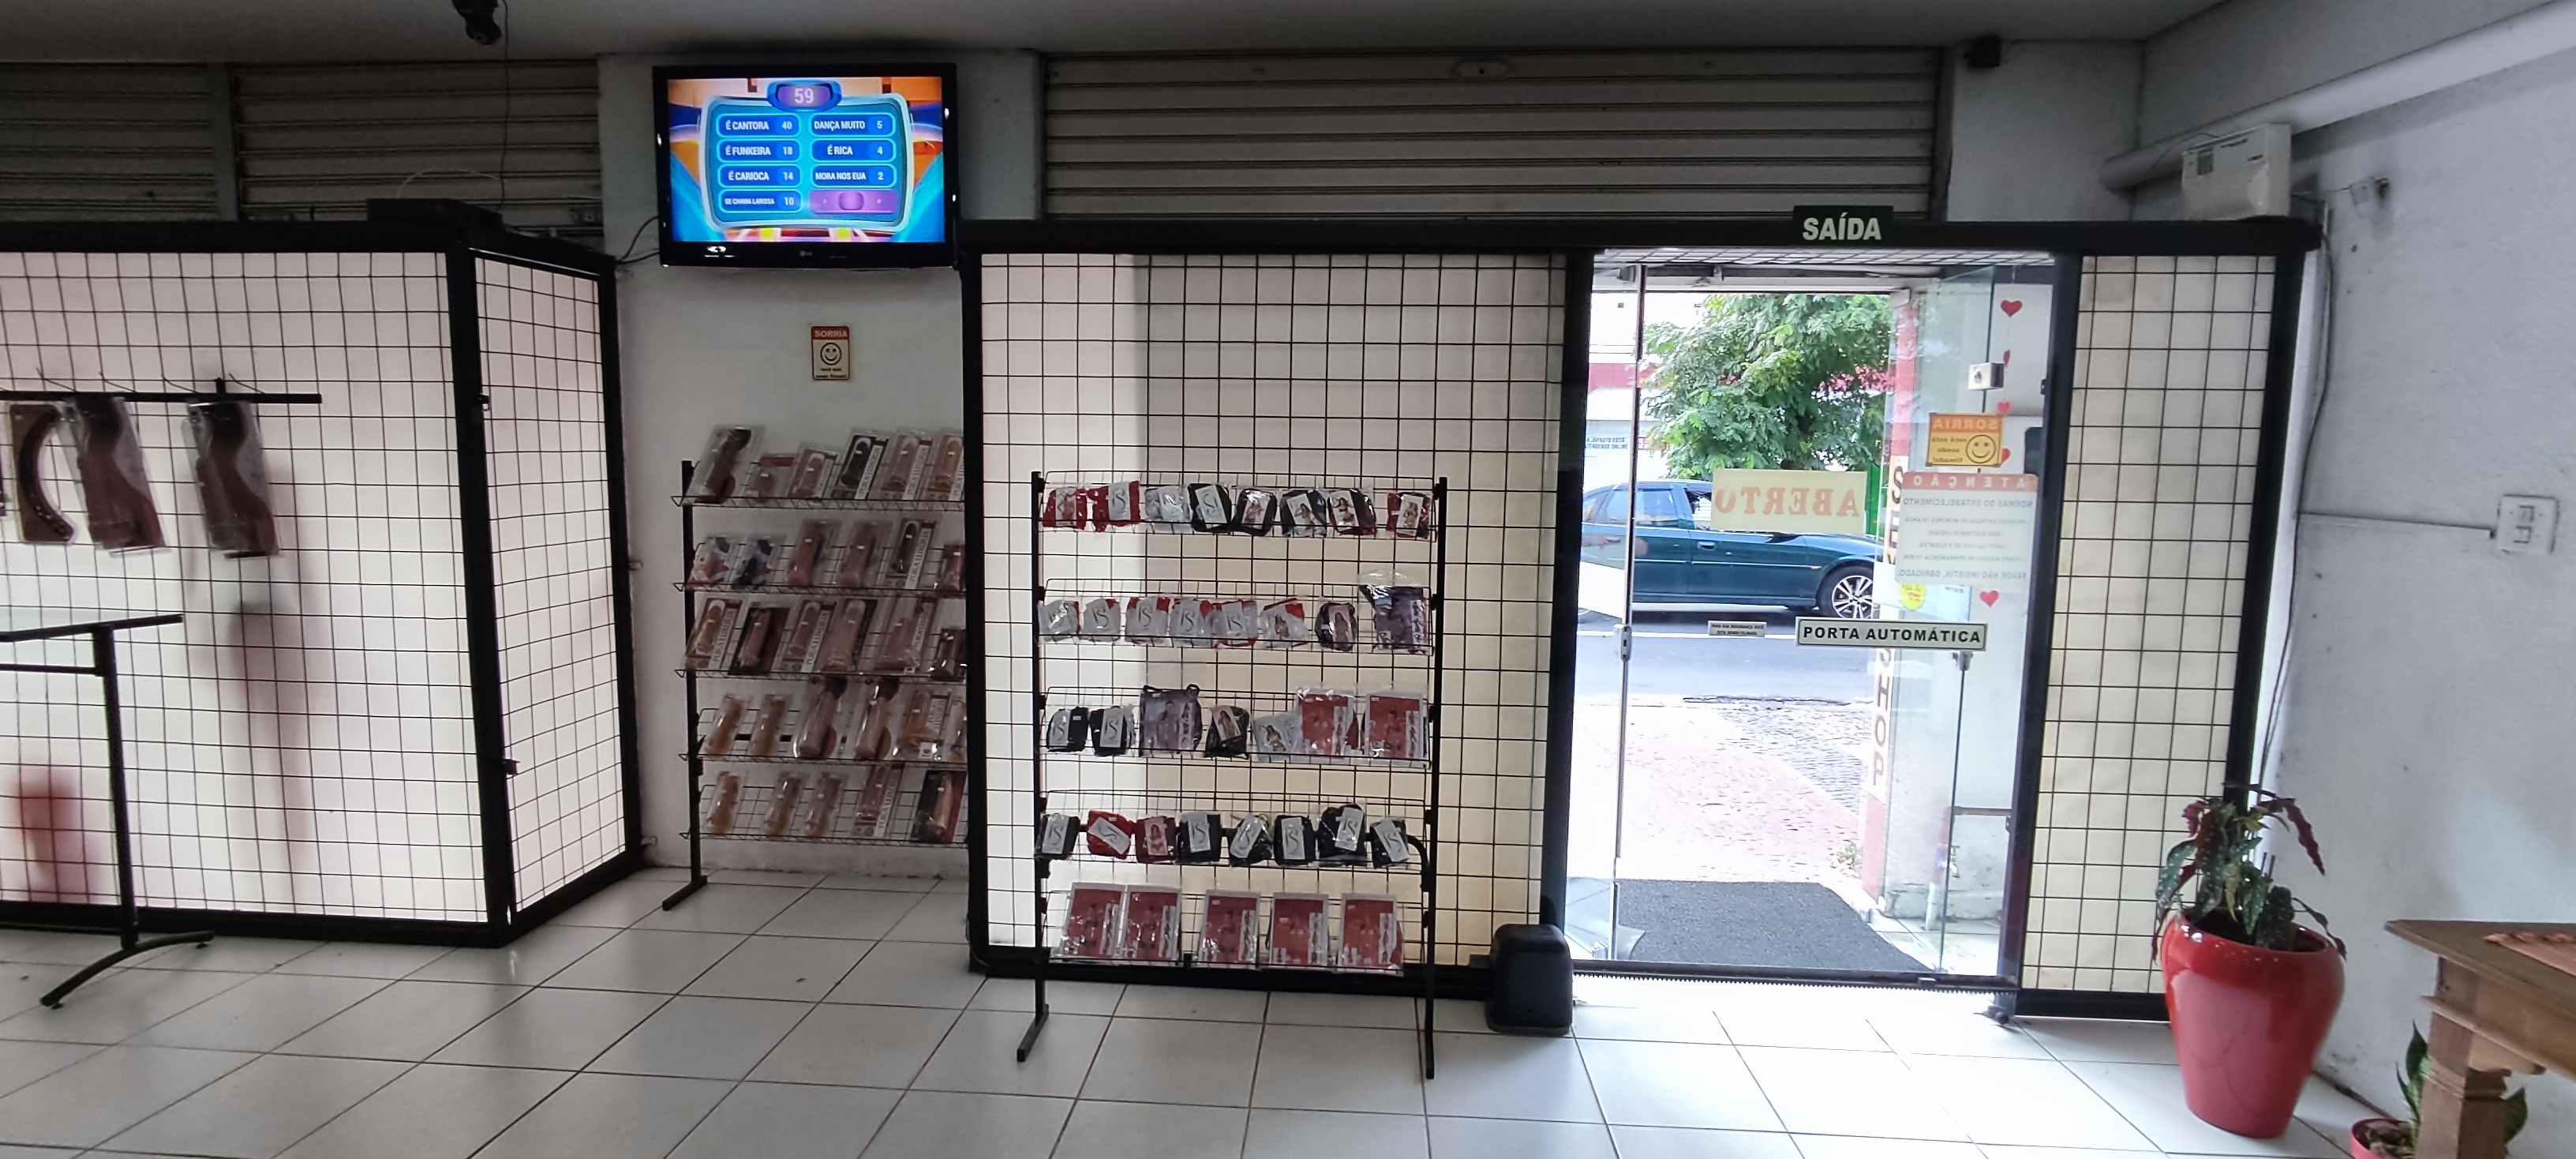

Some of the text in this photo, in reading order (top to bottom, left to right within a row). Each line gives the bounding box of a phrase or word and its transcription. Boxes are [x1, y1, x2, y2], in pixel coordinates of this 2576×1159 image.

[794, 88, 814, 104] 59
[725, 120, 769, 130] É CANTORA
[781, 121, 792, 129] 40
[814, 121, 865, 131] DANÇA MUITO
[877, 121, 882, 129] 5
[725, 144, 771, 156] É FUNKEIRA
[782, 146, 792, 155] 18
[827, 144, 853, 155] É RICA
[877, 146, 883, 155] 4
[728, 170, 769, 181] É CARIOCA
[782, 171, 793, 180] 14
[852, 172, 866, 181] EUA
[878, 172, 884, 181] 2
[784, 197, 794, 206] 10
[1803, 212, 1881, 240] SAÍDA
[1803, 626, 1981, 643] PORTA AUTOMÁTICA
